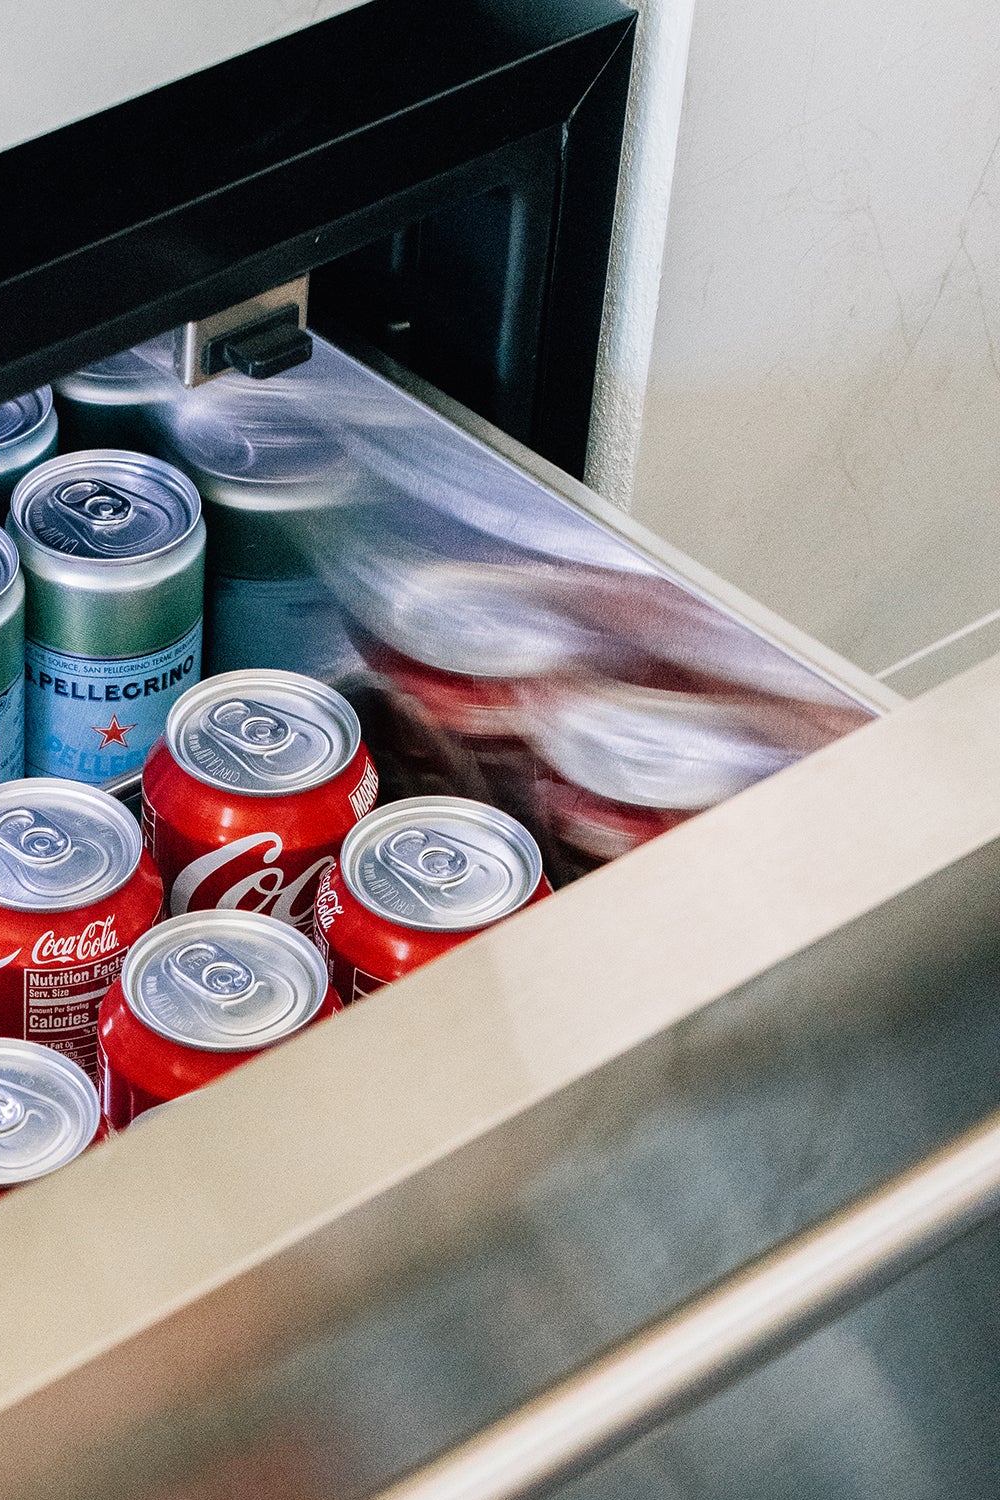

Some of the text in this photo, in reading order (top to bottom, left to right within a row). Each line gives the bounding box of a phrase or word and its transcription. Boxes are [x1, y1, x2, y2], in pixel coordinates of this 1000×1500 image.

[83, 664, 101, 674] SAN
[103, 661, 150, 675] PELLEGRINO
[29, 956, 125, 987] Nutrition Facts
[29, 989, 50, 998] Serv.
[52, 988, 69, 998] Size
[29, 1006, 53, 1014] Amount
[67, 1002, 89, 1012] Serving
[29, 1012, 89, 1029] Calories
[51, 1041, 74, 1050] Fat 0g
